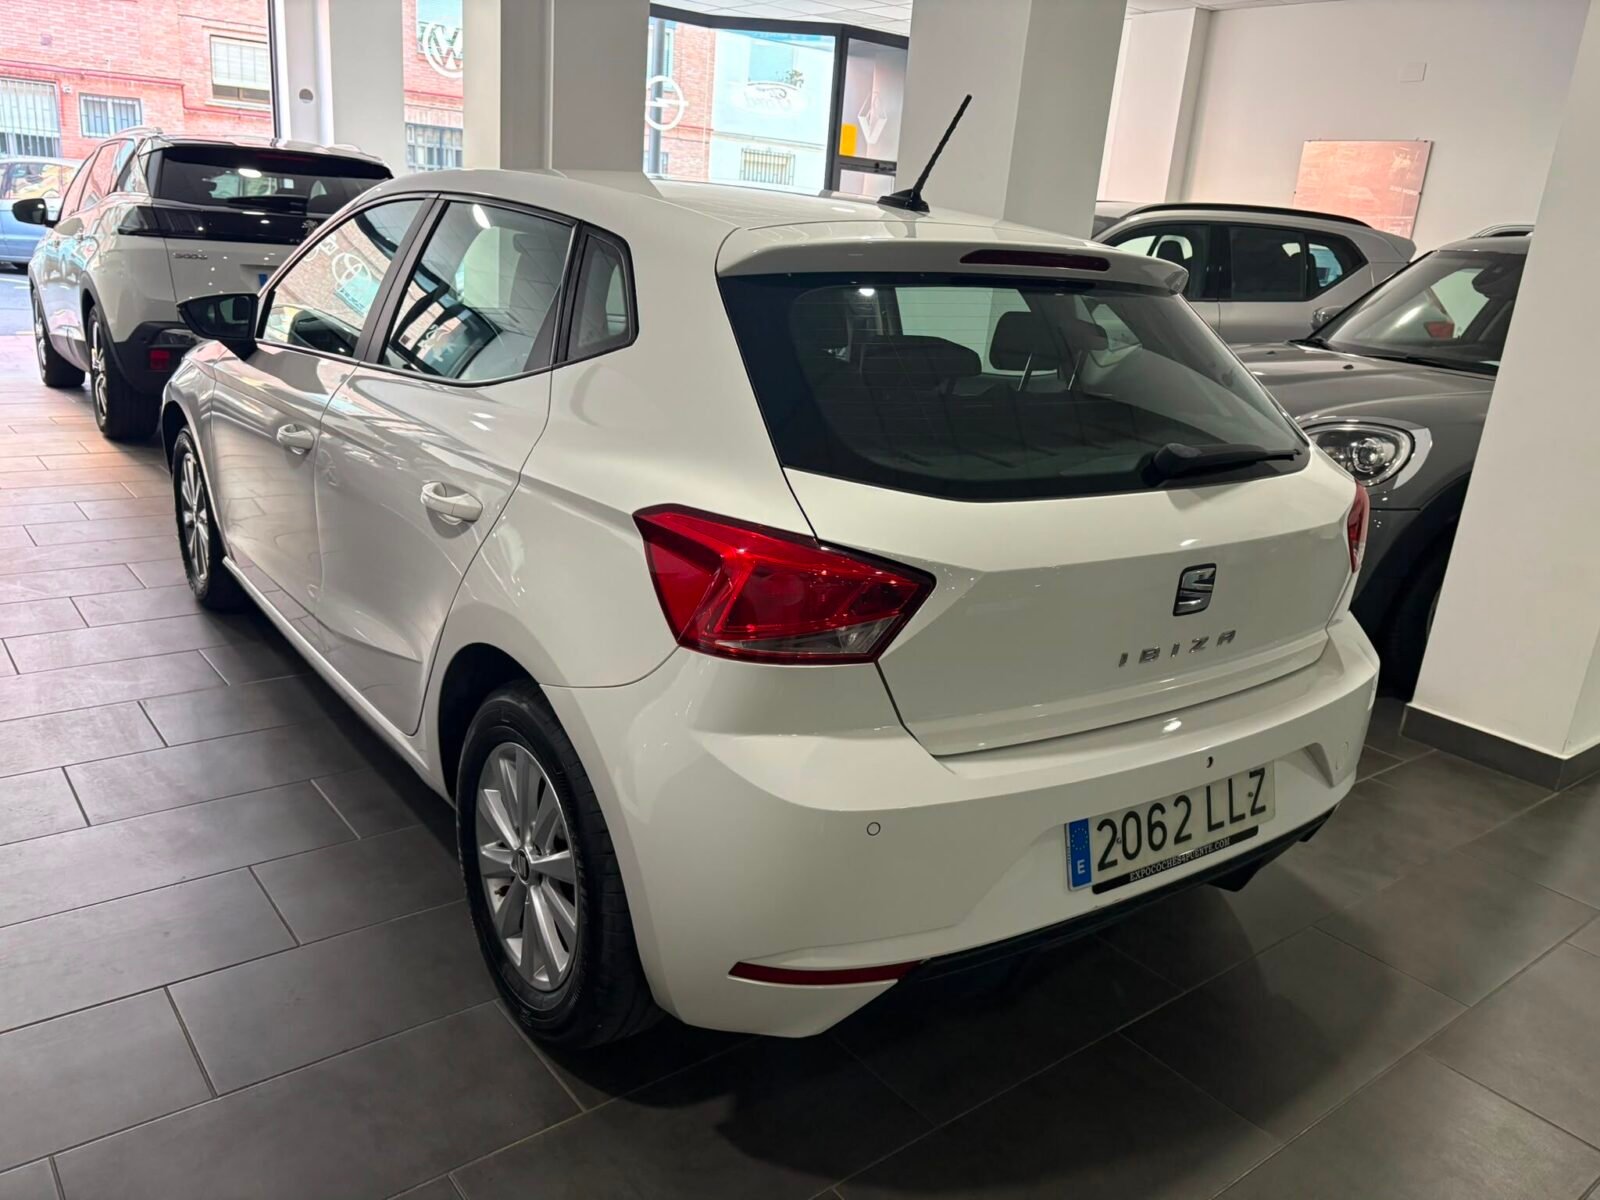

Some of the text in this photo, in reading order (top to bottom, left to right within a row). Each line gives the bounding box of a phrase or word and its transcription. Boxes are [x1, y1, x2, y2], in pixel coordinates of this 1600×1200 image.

[1118, 629, 1236, 668] IBIZA
[1096, 767, 1266, 872] 2062 LLZ
[1076, 859, 1086, 875] E
